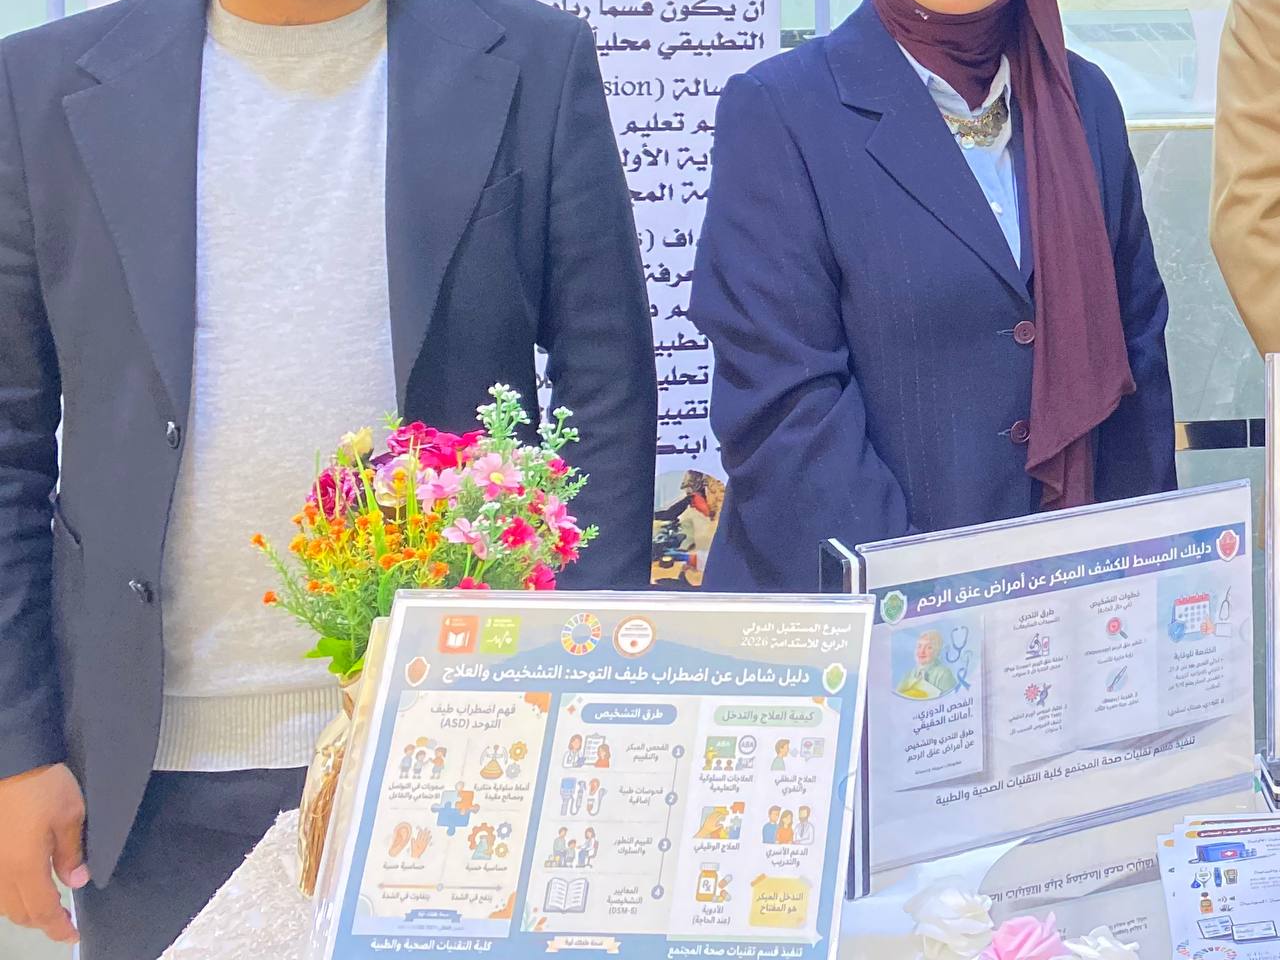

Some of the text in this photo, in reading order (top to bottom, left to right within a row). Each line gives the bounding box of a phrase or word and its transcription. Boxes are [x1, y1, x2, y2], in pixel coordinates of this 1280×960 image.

[657, 32, 764, 60] التطبيقي
[620, 112, 685, 138] تعليم
[916, 542, 1212, 611] دليلك المبسط للكشف المبكر عن أمراض عنق الرحم
[742, 622, 820, 636] المستقبل الدولي
[820, 640, 848, 652] الرابع
[442, 663, 811, 688] دليل شامل عن اضطراب طيف التوحد: التشخيص والعلاج
[430, 703, 517, 719] فهم اضطراب طيف
[946, 698, 974, 713] الفحص
[594, 708, 664, 722] طرق التشخيص
[722, 710, 815, 724] كيفية العلاج والتدخل
[440, 718, 502, 731] التوحد (ASD)
[913, 716, 946, 736] الحقيقي
[1064, 758, 1100, 778] المجتمع
[1101, 754, 1122, 767] صحة
[1006, 771, 1041, 789] التقنيات
[1042, 766, 1063, 781] كلية
[972, 779, 1004, 797] الصحية
[935, 788, 970, 806] والطبية
[780, 891, 804, 902] التدخل
[370, 938, 493, 953] كلية التقنيات الصحية والطبية
[667, 943, 702, 959] المجتمع
[703, 944, 726, 957] صحة
[726, 944, 757, 957] تقنيات
[757, 945, 777, 959] قسم
